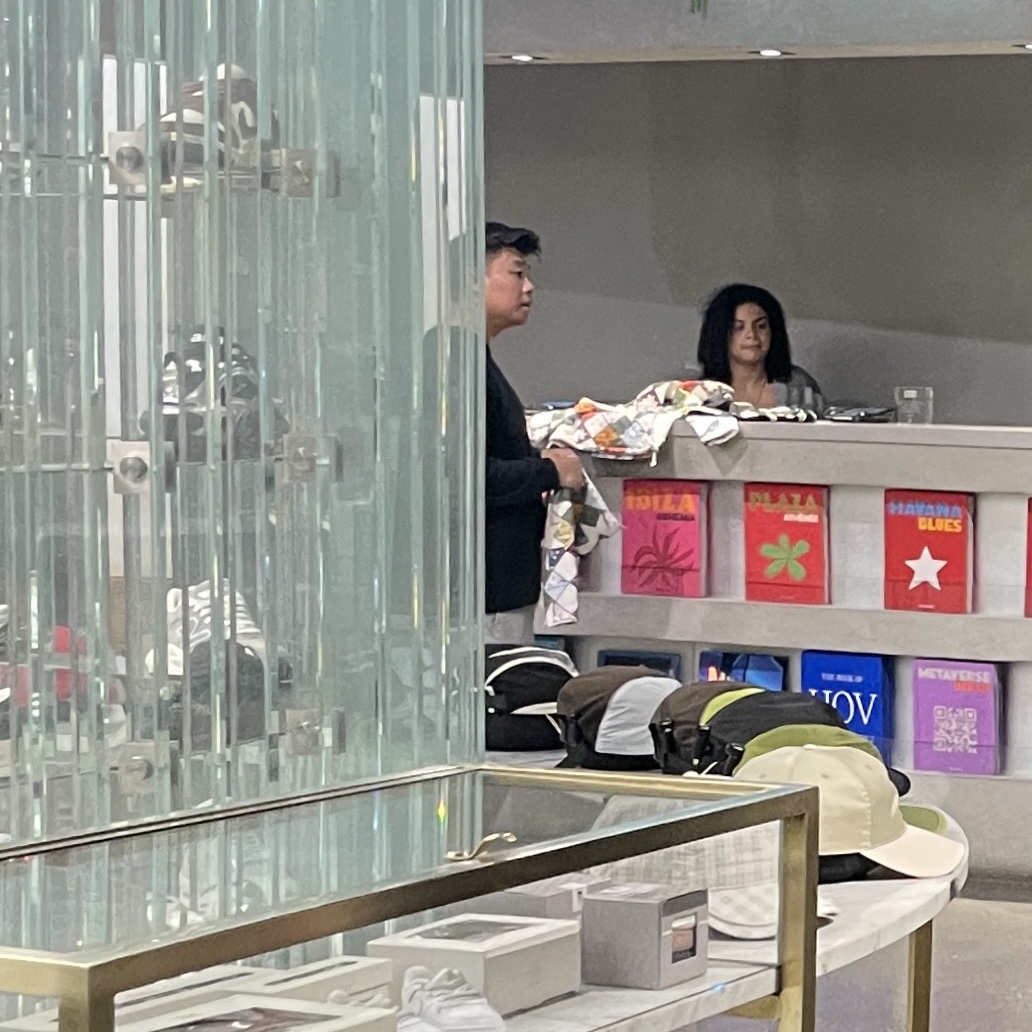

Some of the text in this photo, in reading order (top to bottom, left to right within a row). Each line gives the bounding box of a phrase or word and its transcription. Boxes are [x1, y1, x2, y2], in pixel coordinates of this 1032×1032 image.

[749, 491, 818, 514] PLAZA
[888, 501, 962, 519] HAVANA
[918, 516, 963, 533] BLUES
[917, 666, 991, 683] METAVERSE
